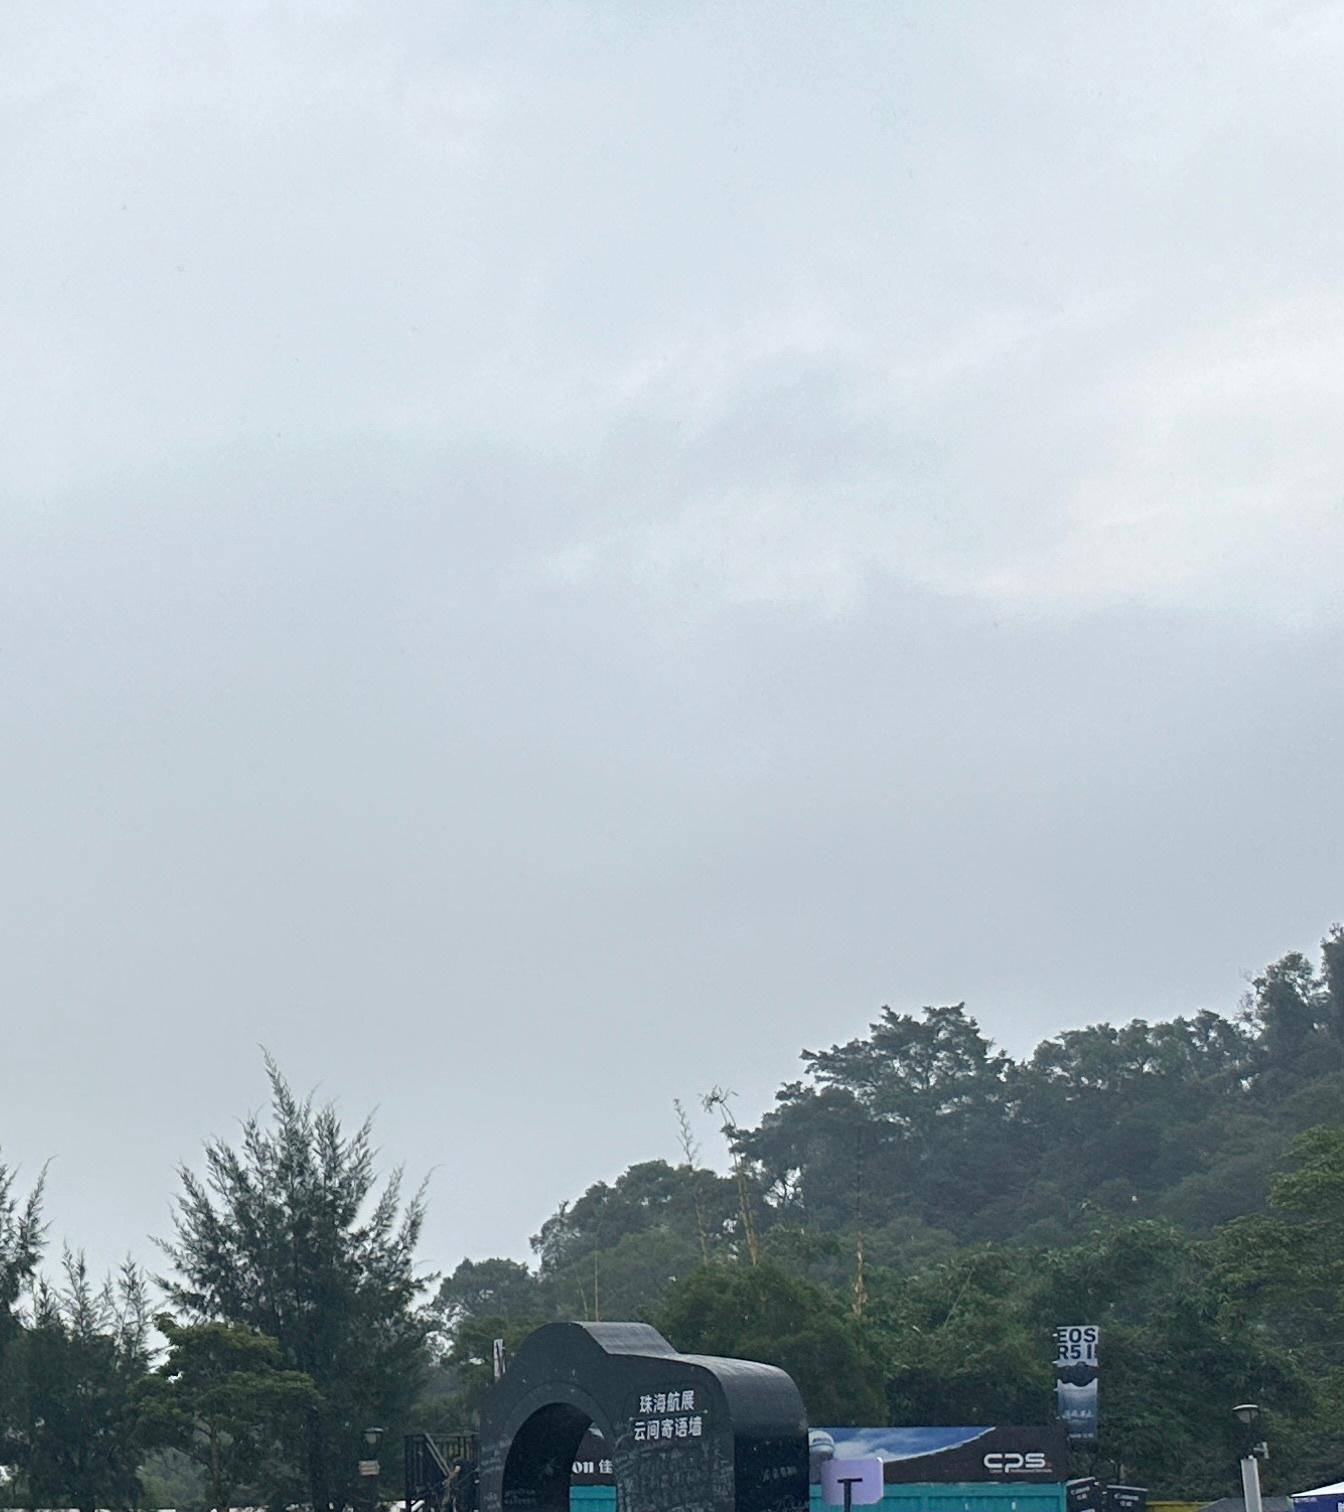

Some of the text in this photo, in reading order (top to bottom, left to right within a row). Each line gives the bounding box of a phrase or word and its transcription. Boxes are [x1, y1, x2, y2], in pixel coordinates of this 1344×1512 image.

[1057, 1327, 1097, 1344] EOS
[1057, 1344, 1081, 1360] R5
[639, 1390, 695, 1414] 珠海航展
[634, 1416, 703, 1441] 云间寄语墙
[571, 1459, 613, 1474] on 佳
[983, 1452, 1046, 1473] CPS
